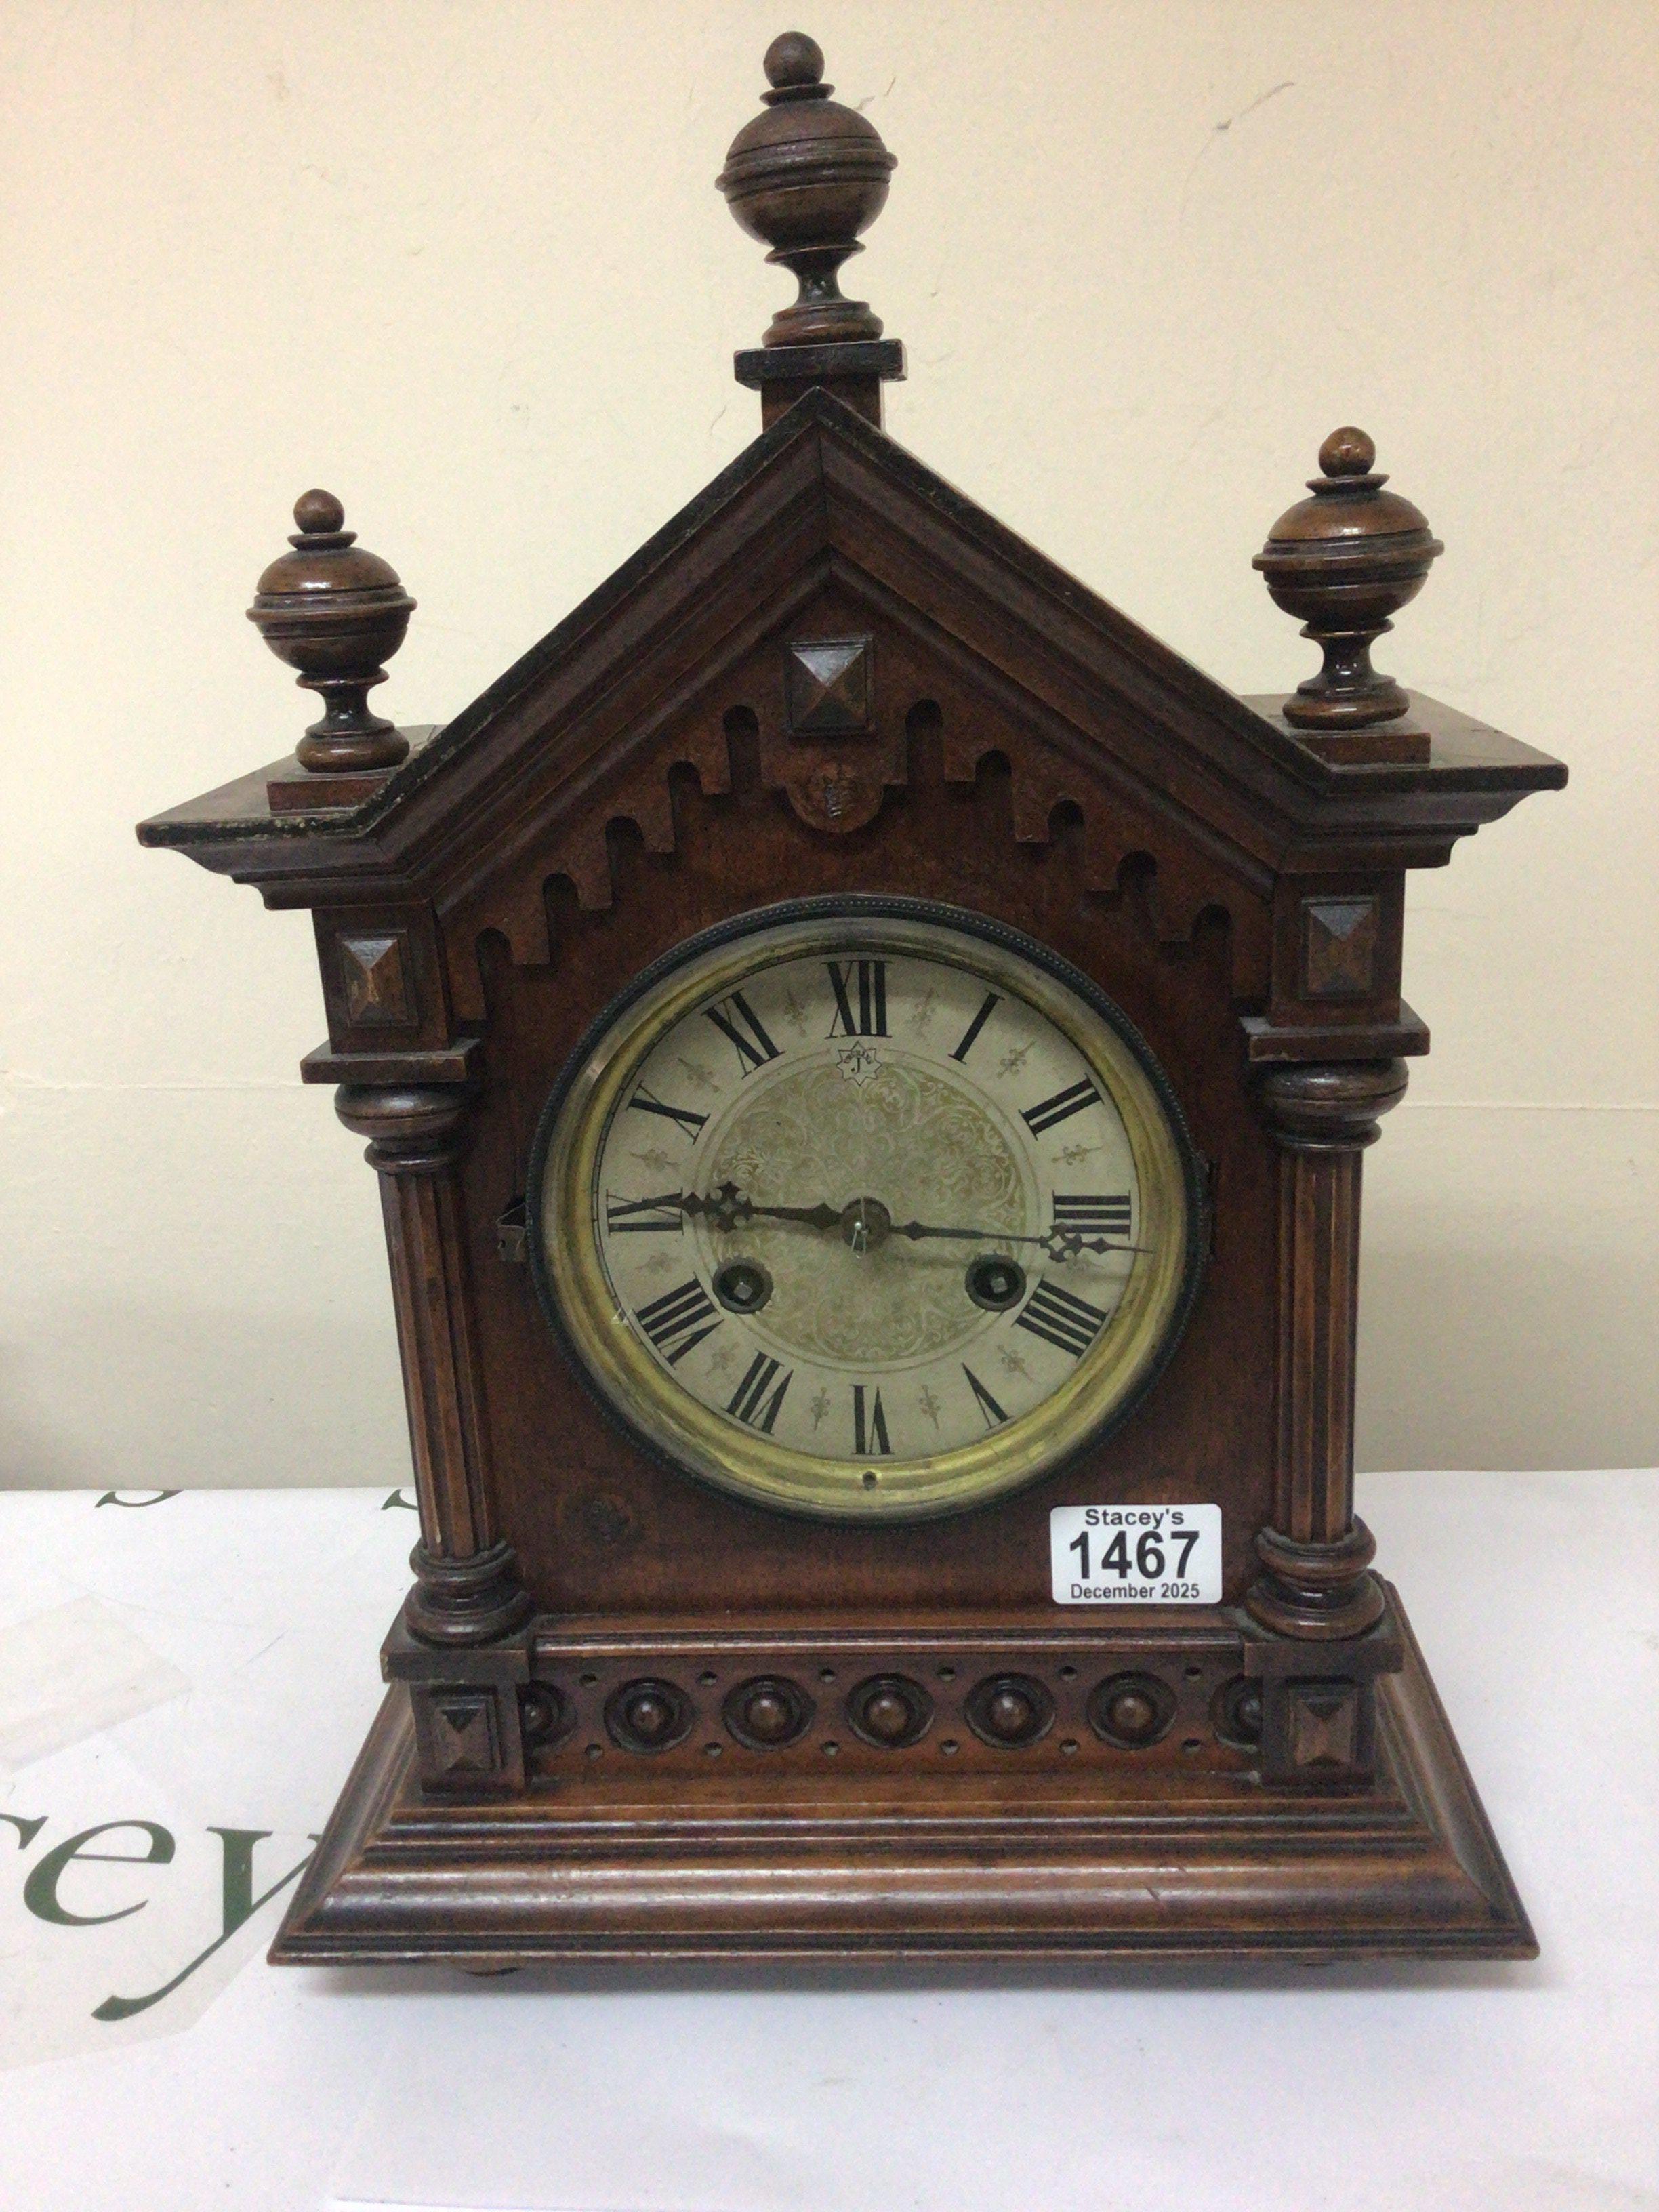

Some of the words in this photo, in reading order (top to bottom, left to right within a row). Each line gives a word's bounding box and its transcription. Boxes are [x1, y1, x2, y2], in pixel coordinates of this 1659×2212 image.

[701, 987, 785, 1080] XI
[821, 960, 891, 1039] XII
[949, 989, 1005, 1065] I
[626, 1080, 711, 1145] X
[1018, 1072, 1105, 1141] II
[606, 1187, 684, 1237] IX
[1052, 1189, 1132, 1240] III
[632, 1271, 725, 1370] VIII
[1011, 1272, 1112, 1363] IIII
[720, 1348, 794, 1436] VII
[849, 1384, 895, 1455] VI
[961, 1361, 1013, 1431] V
[1085, 1508, 1185, 1530] Stacey's
[1069, 1530, 1200, 1580] 1467
[1071, 1582, 1155, 1599] December
[1160, 1583, 1200, 1599] 2025
[0, 1813, 321, 2022] ey
